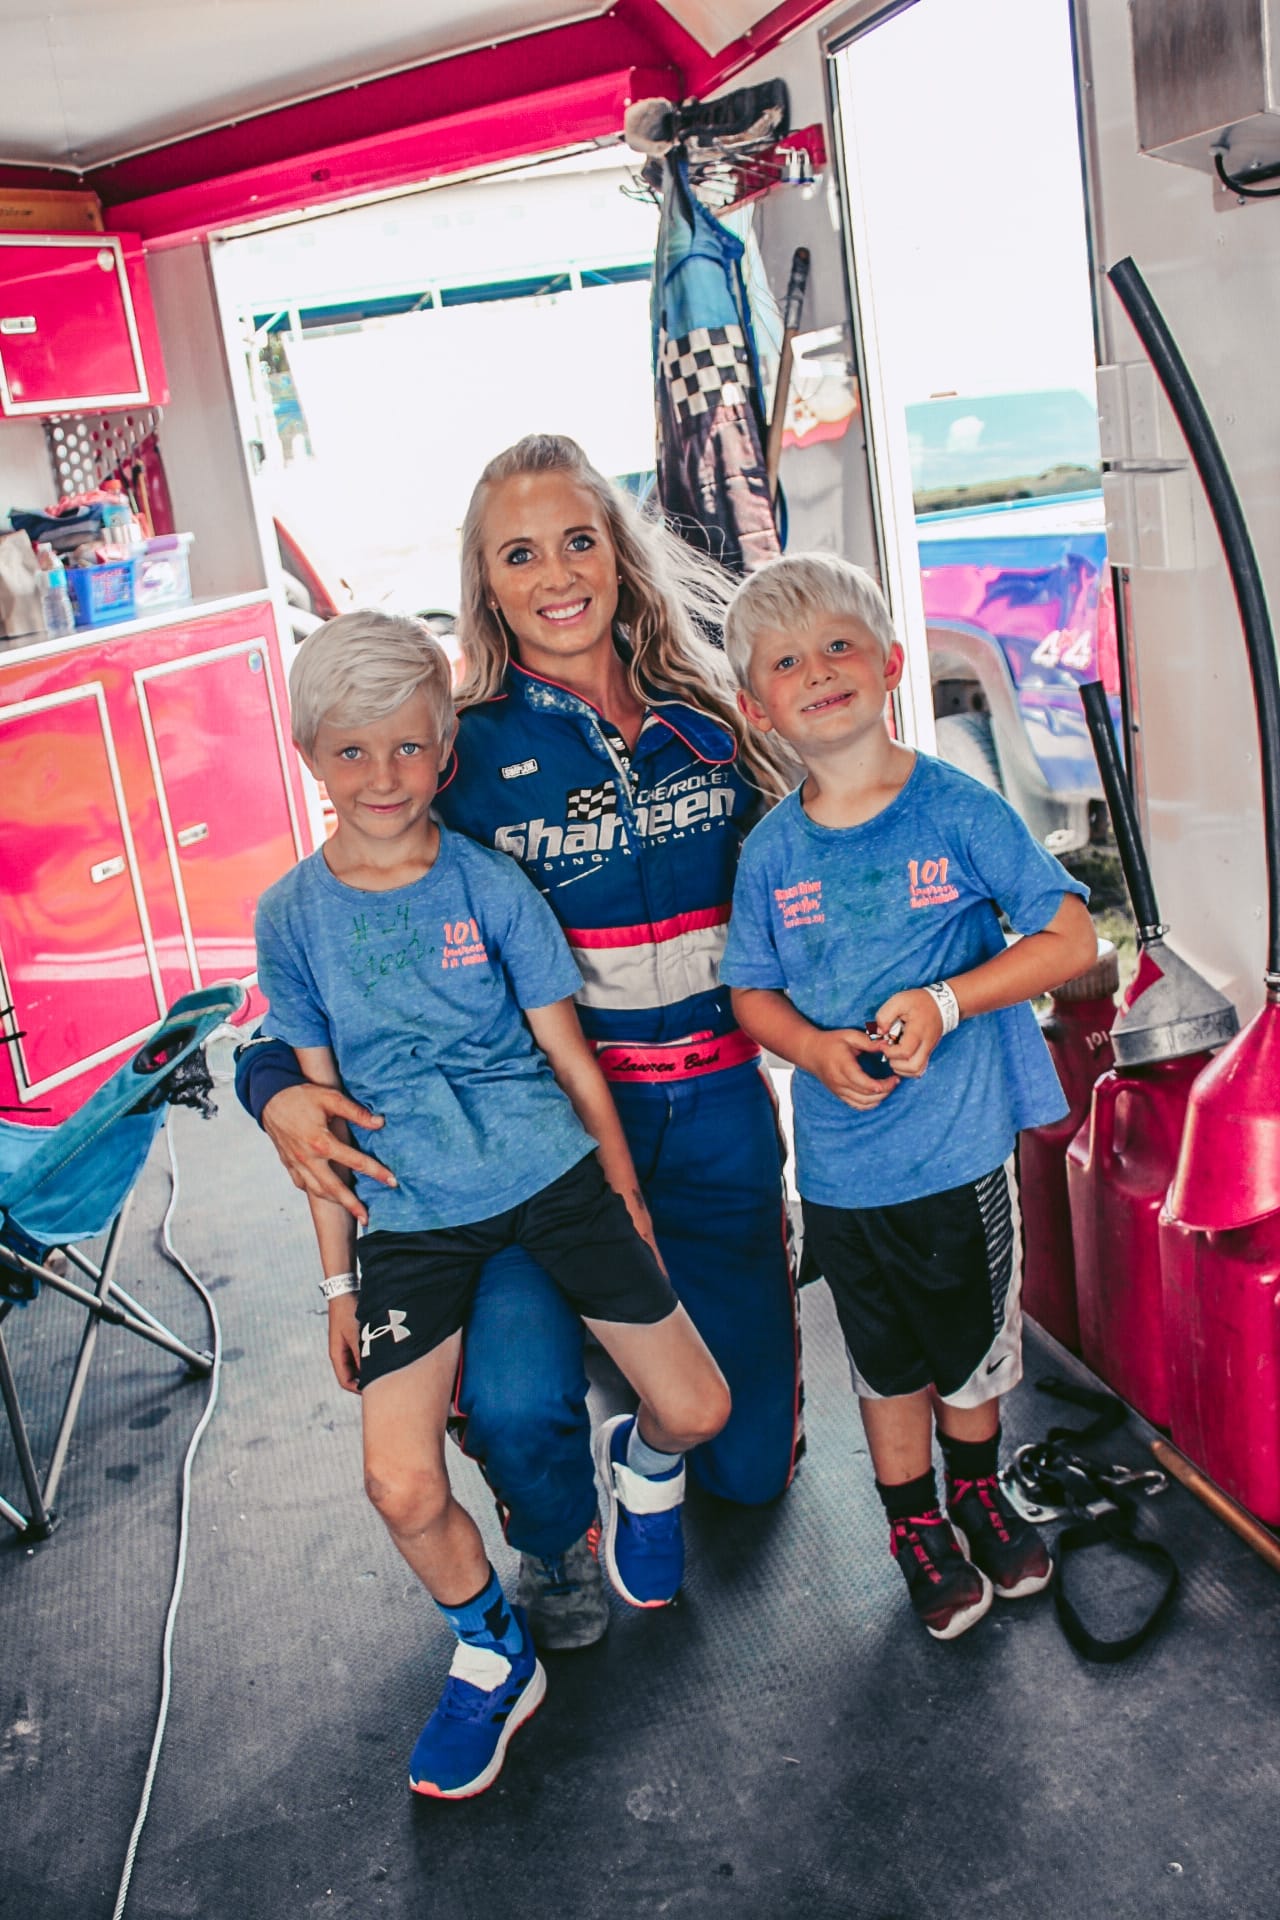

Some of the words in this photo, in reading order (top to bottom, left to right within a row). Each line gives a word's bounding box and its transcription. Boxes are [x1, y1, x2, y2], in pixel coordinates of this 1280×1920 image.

[1030, 628, 1092, 670] 44
[908, 857, 949, 887] 101
[443, 917, 480, 945] 101
